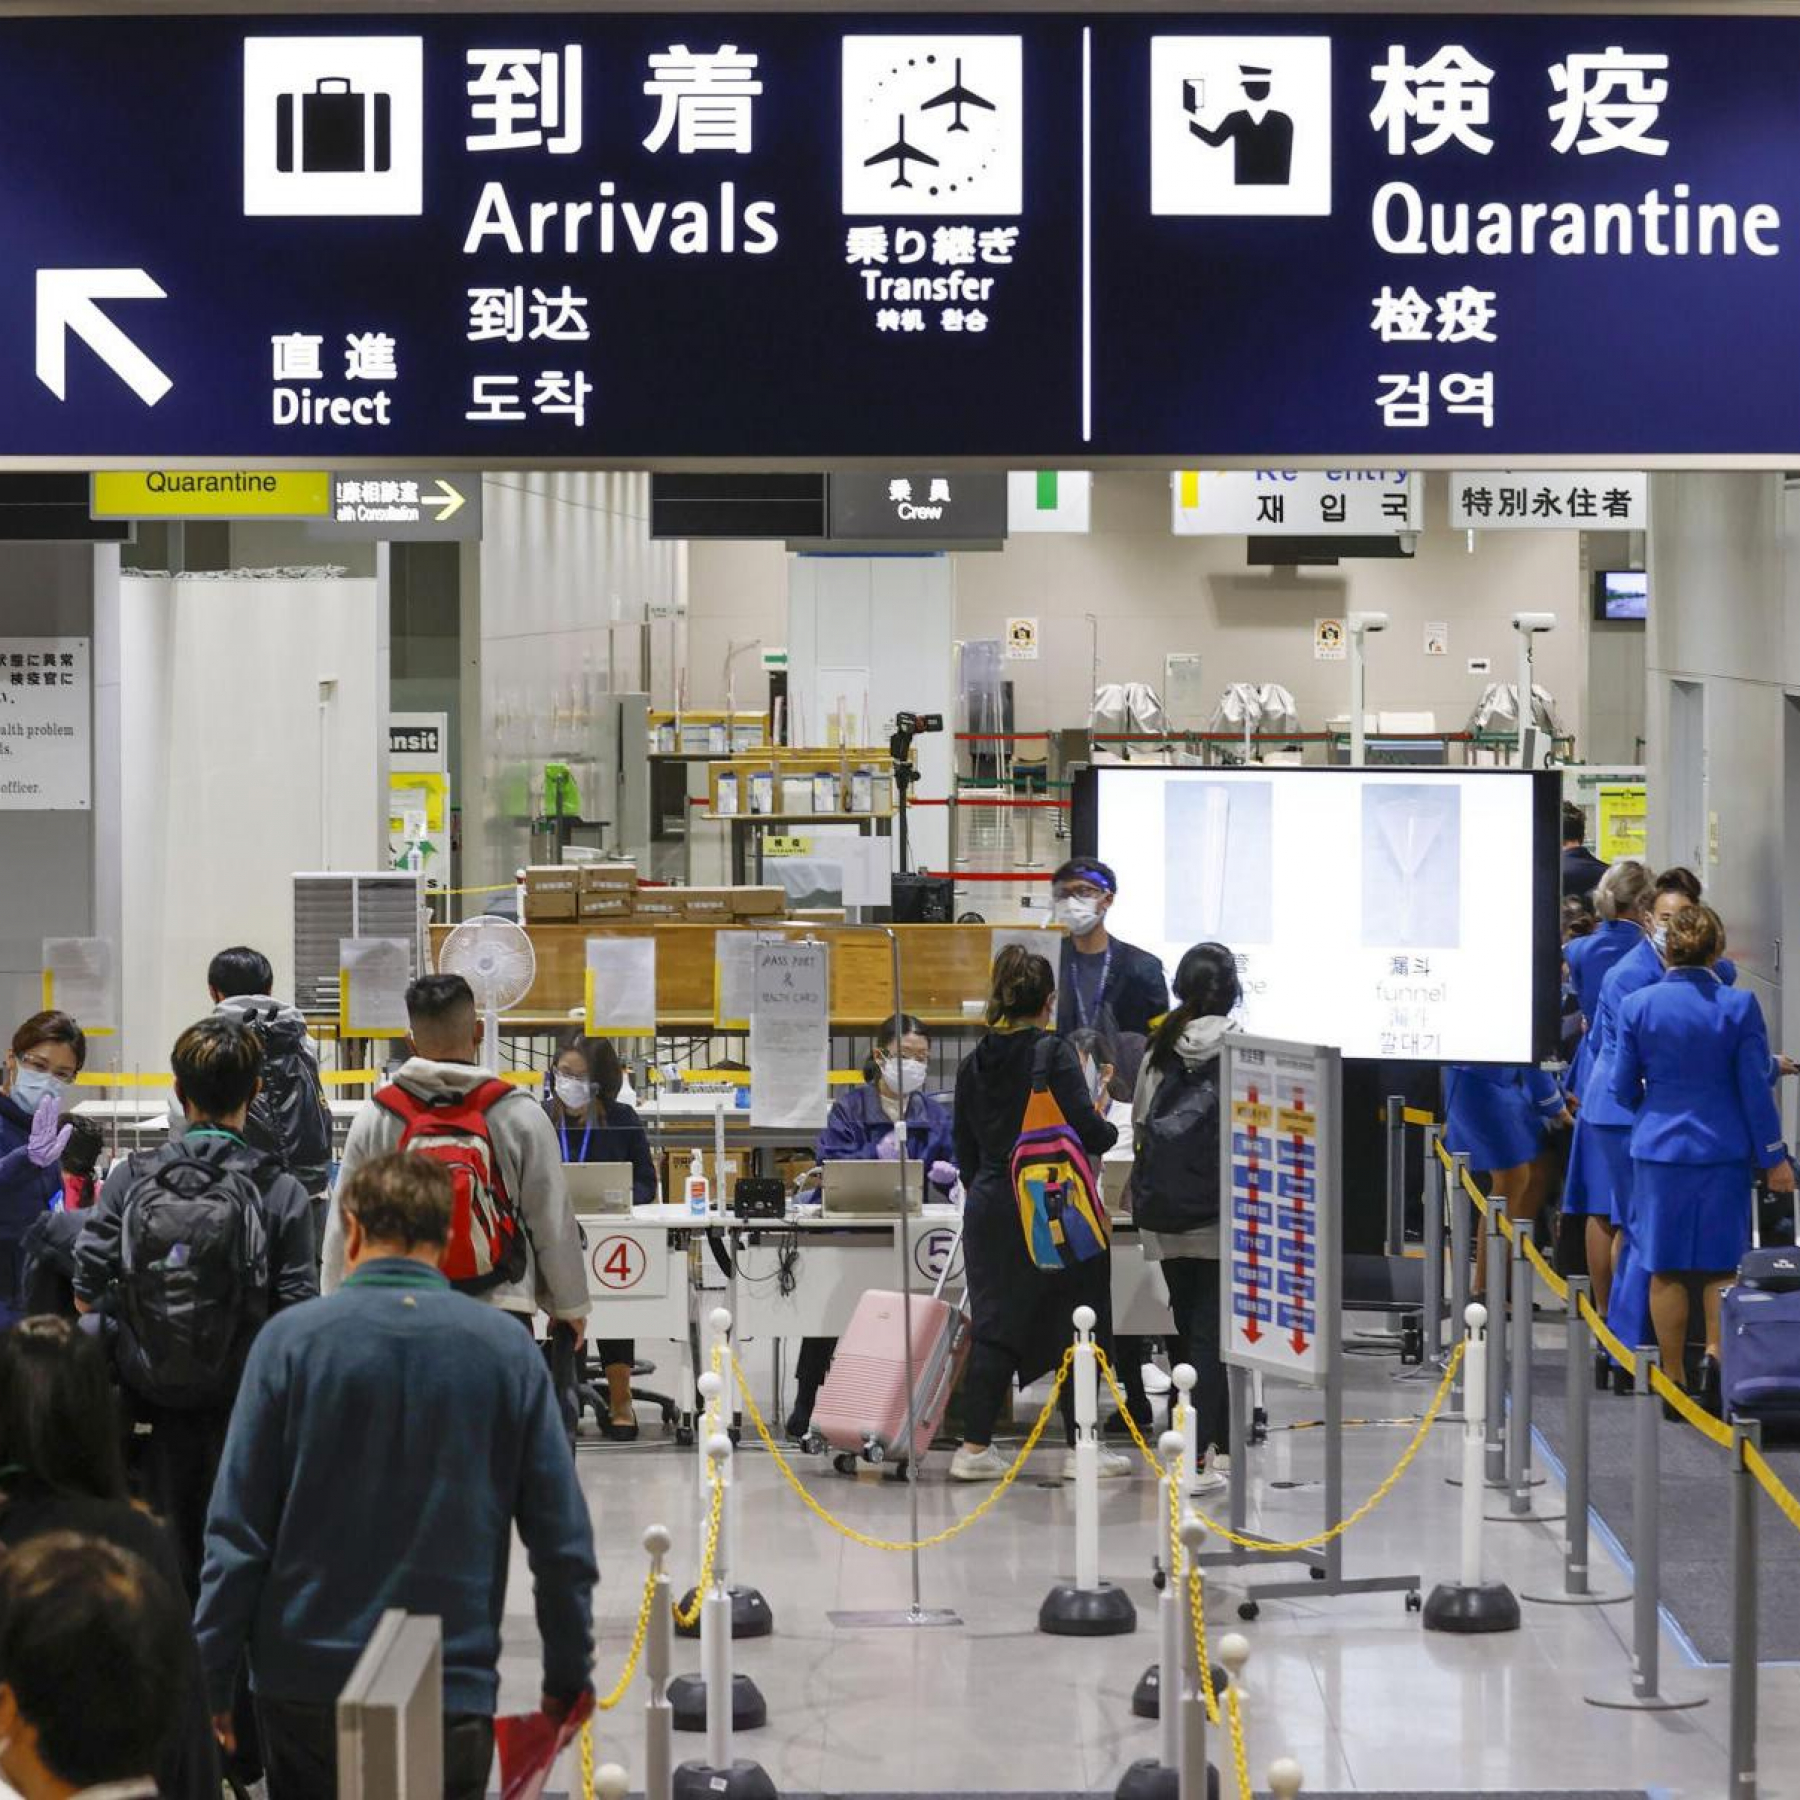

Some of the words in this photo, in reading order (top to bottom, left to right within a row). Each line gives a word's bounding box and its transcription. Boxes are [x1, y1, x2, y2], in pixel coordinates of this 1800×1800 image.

[465, 44, 764, 154] 到着
[1369, 44, 1670, 156] 検疫
[462, 181, 779, 254] Arrivals
[1371, 181, 1780, 256] Quarantine
[845, 225, 1020, 266] 乗り継ぎ
[860, 269, 995, 302] Transfer
[466, 285, 591, 343] 到达
[1370, 285, 1498, 344] 检疫
[270, 331, 398, 381] 直進
[272, 387, 391, 426] Direct
[465, 370, 593, 427] 도착
[1374, 370, 1494, 428] 검역
[146, 472, 277, 494] Quarantine
[1461, 486, 1632, 518] 特別永住者
[897, 501, 943, 521] Crew
[26, 723, 74, 739] problem
[1375, 981, 1446, 1003] funnel
